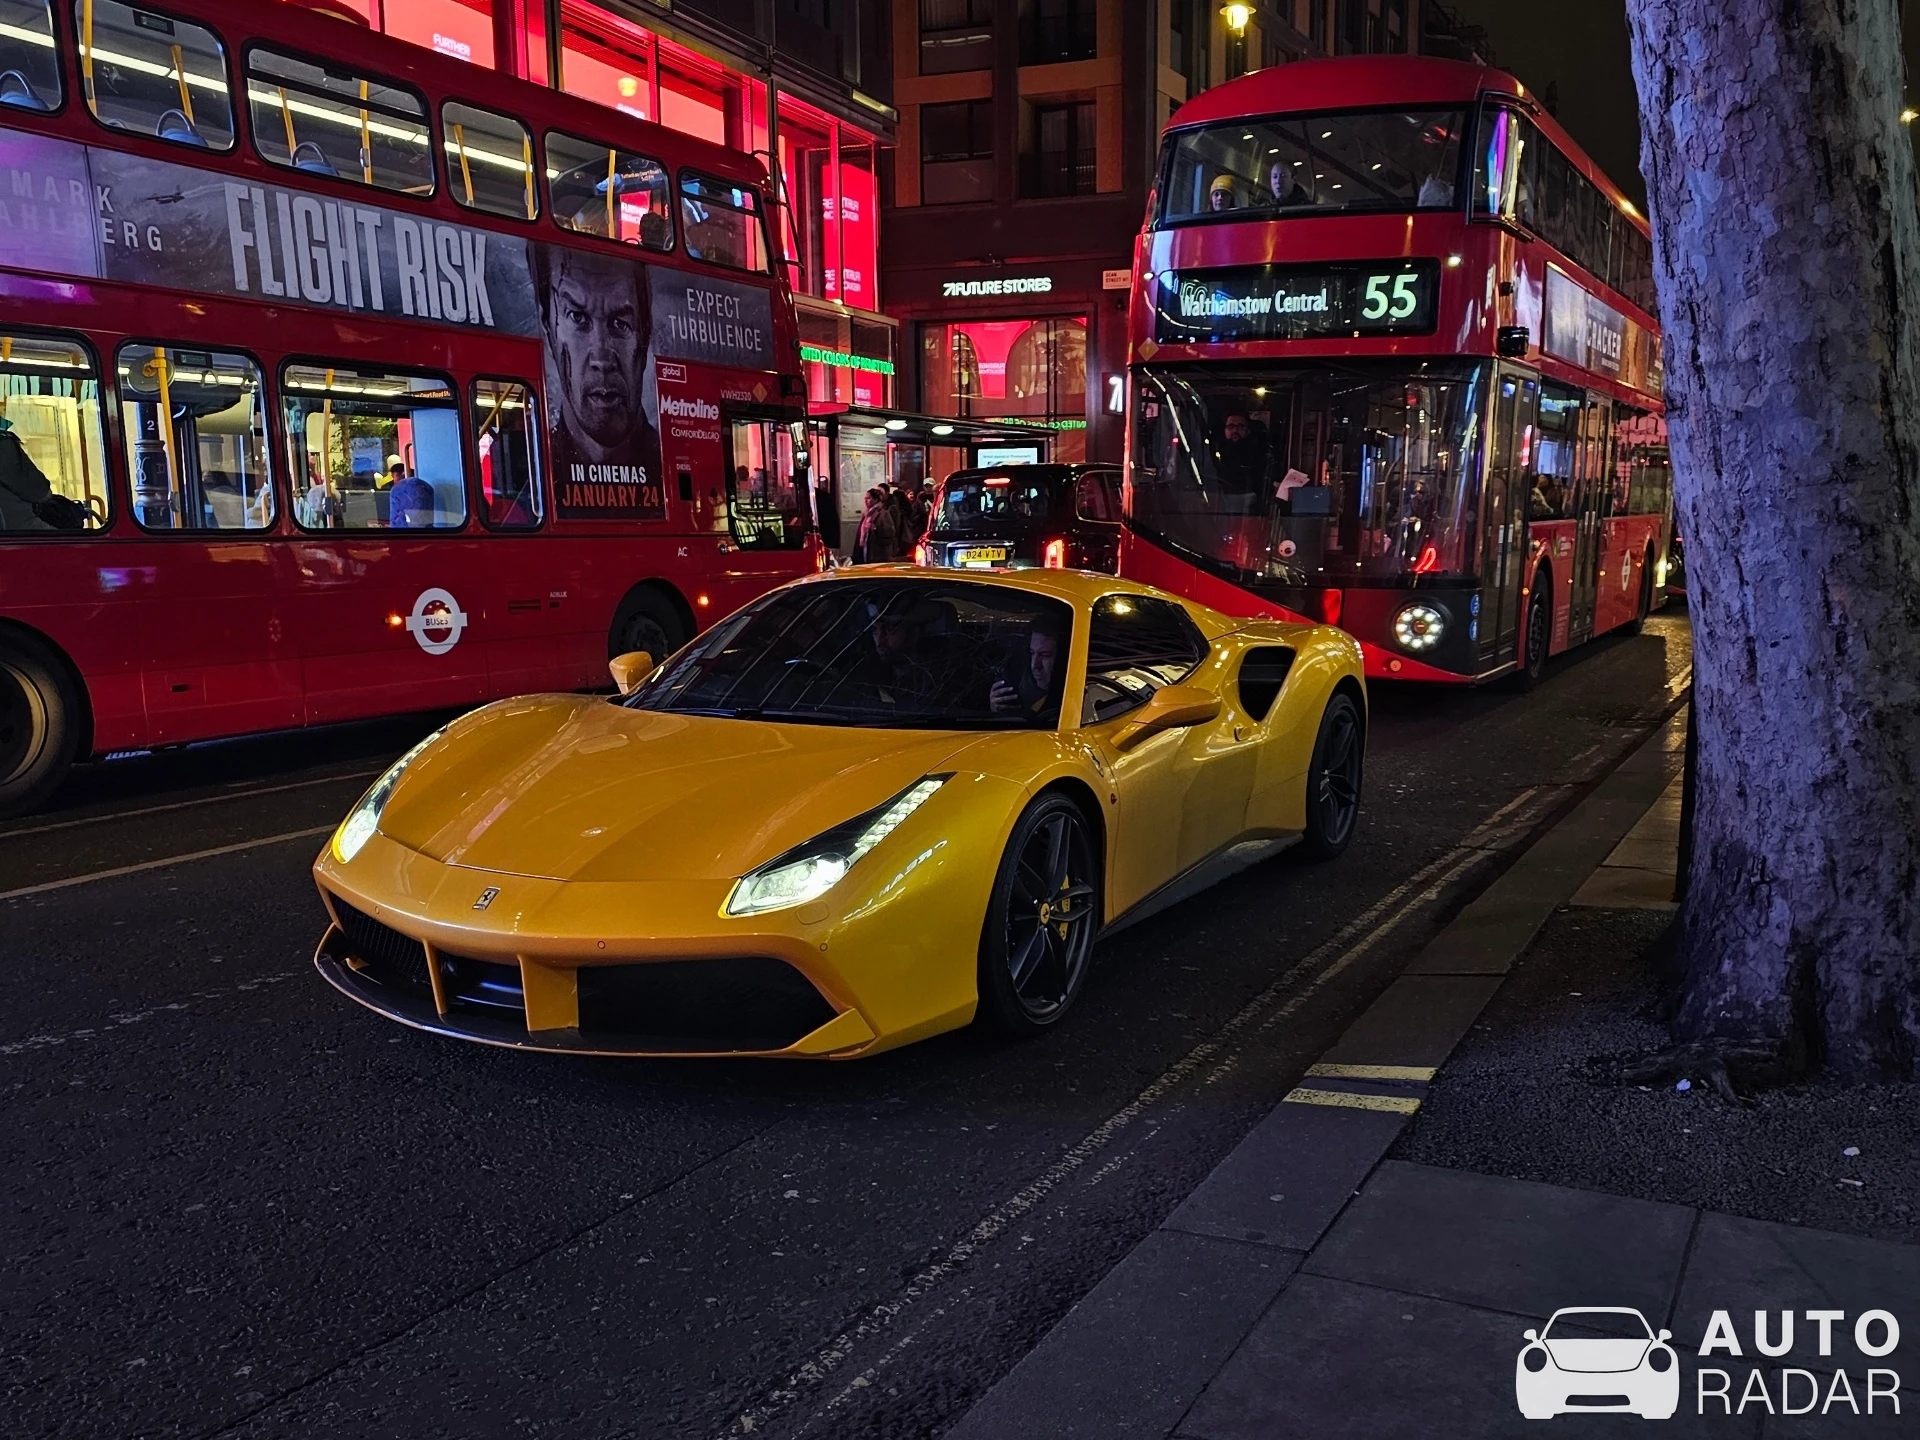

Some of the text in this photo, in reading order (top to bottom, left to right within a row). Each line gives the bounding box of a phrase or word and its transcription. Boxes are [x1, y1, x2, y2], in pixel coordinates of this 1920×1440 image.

[11, 169, 115, 213] MARK
[0, 202, 163, 252] AHLBERG
[224, 182, 495, 327] FLIGHT RISK
[955, 277, 1052, 296] FUTURE STORES
[1180, 274, 1418, 320] Walthamstow Central 55
[686, 288, 740, 319] EXPECT
[668, 315, 762, 352] TURBULENCE
[662, 366, 681, 378] global
[720, 389, 752, 401] VWH2320
[660, 394, 719, 420] Metroline
[147, 420, 155, 430] 2
[571, 464, 647, 483] IN CINEMAS
[562, 484, 659, 507] JANUARY 24
[677, 547, 688, 557] AC
[425, 618, 449, 626] BUSES
